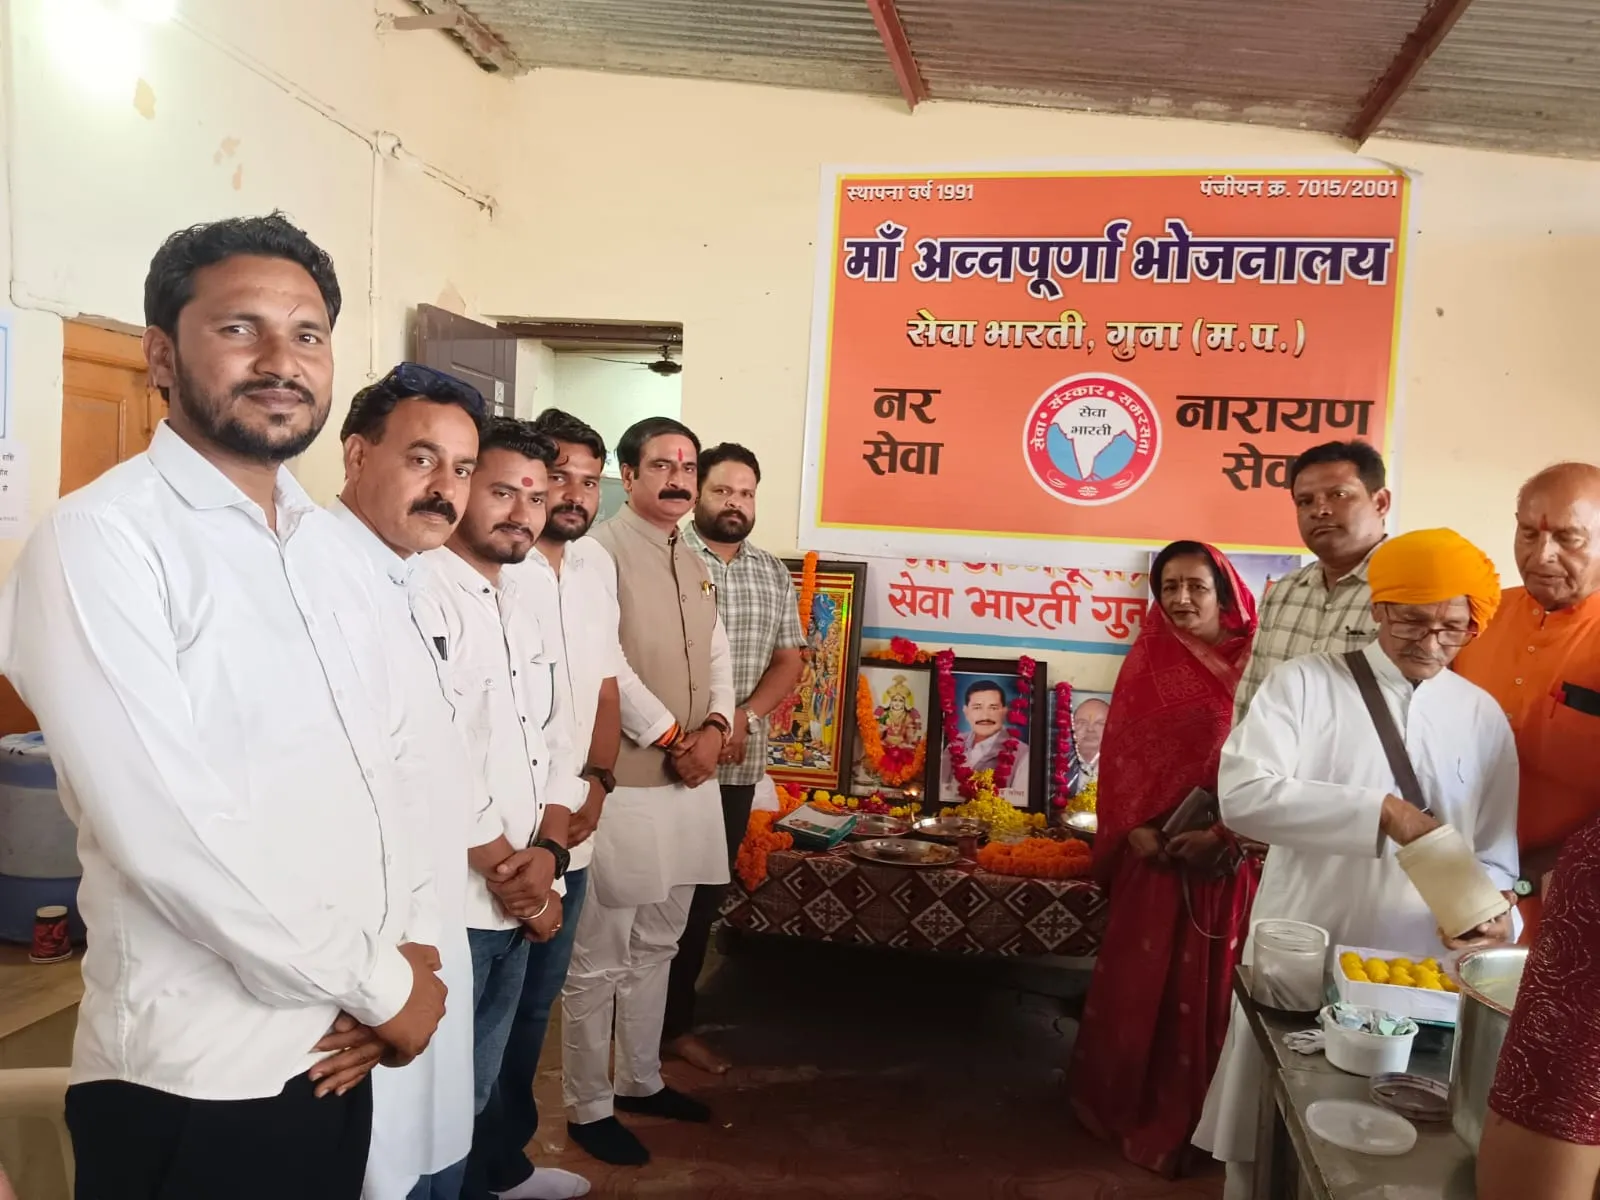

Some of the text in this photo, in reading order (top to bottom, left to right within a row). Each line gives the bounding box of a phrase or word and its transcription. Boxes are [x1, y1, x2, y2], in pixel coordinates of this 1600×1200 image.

[846, 179, 975, 202] स्थापना वर्ष 1991
[1199, 175, 1398, 198] पंजीयन क्र. 7015/2001
[843, 218, 1395, 301] माँ अन्नपूर्णा भोजनालय
[906, 309, 978, 349] सेवा
[983, 310, 1096, 354] भारती,
[1105, 321, 1184, 361] गुना
[873, 387, 942, 425] नर
[1078, 405, 1108, 419] सेवा
[1175, 395, 1375, 436] नारायण
[1070, 423, 1113, 437] भारती
[862, 430, 945, 476] सेवा
[1221, 442, 1301, 491] सेव
[888, 571, 954, 619] सेवा
[964, 580, 1081, 630] भारती
[1091, 595, 1149, 639] गुन
